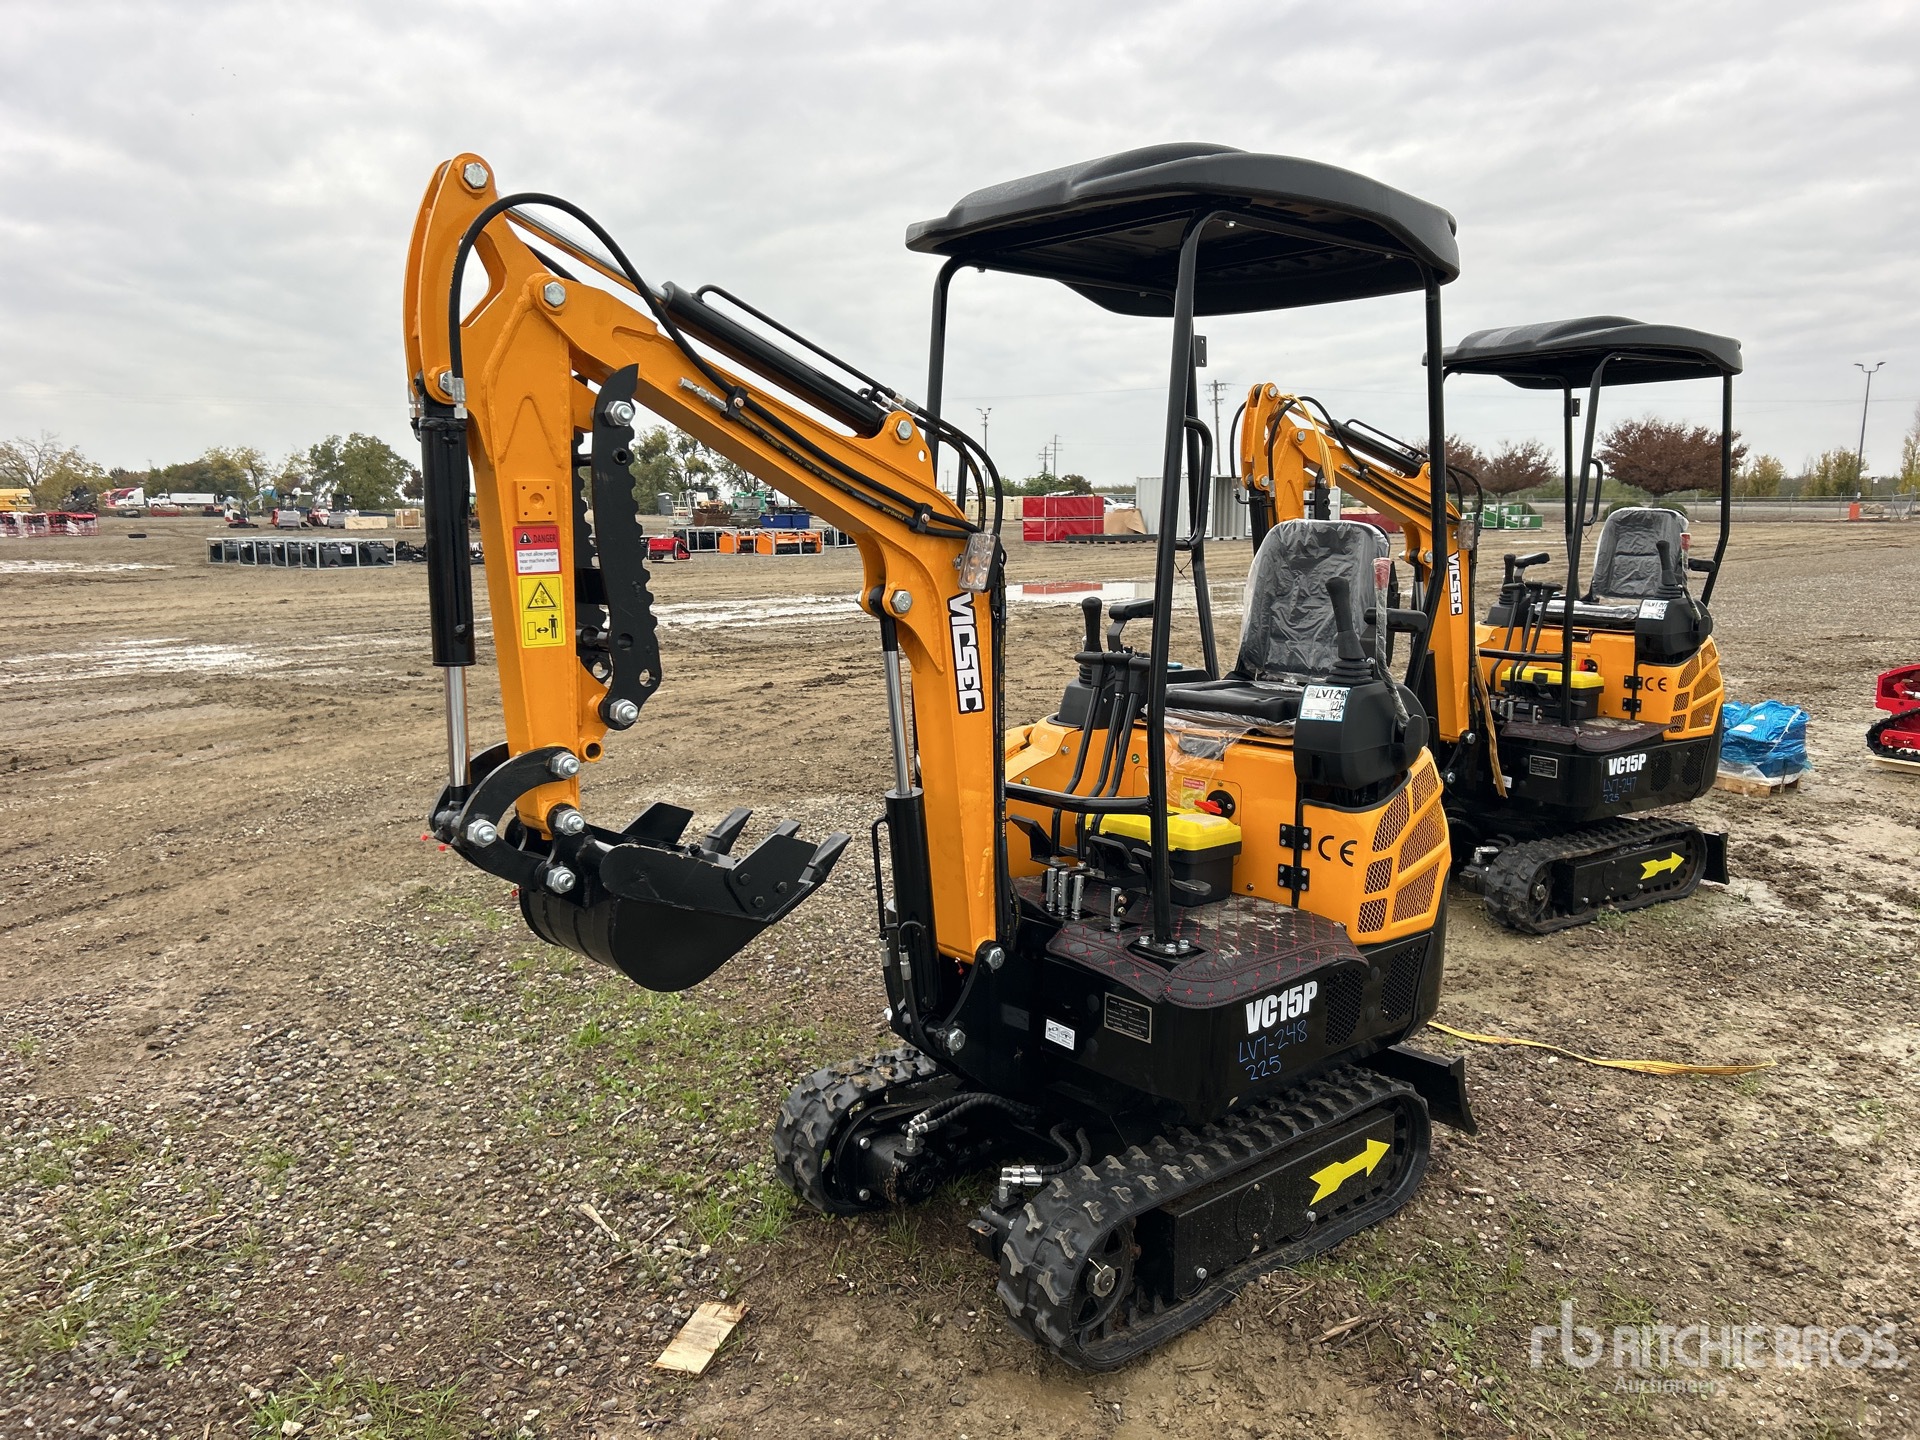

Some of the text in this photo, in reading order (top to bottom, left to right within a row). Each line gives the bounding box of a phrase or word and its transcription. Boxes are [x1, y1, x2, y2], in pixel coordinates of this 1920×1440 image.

[533, 534, 557, 543] DANGER
[1447, 552, 1463, 616] VICSEC
[948, 591, 985, 713] VICSEC
[1608, 753, 1647, 776] VC15P
[1602, 793, 1620, 804] 225
[1317, 835, 1358, 867] CE
[1245, 980, 1318, 1035] VC15P
[1245, 1054, 1283, 1081] 225
